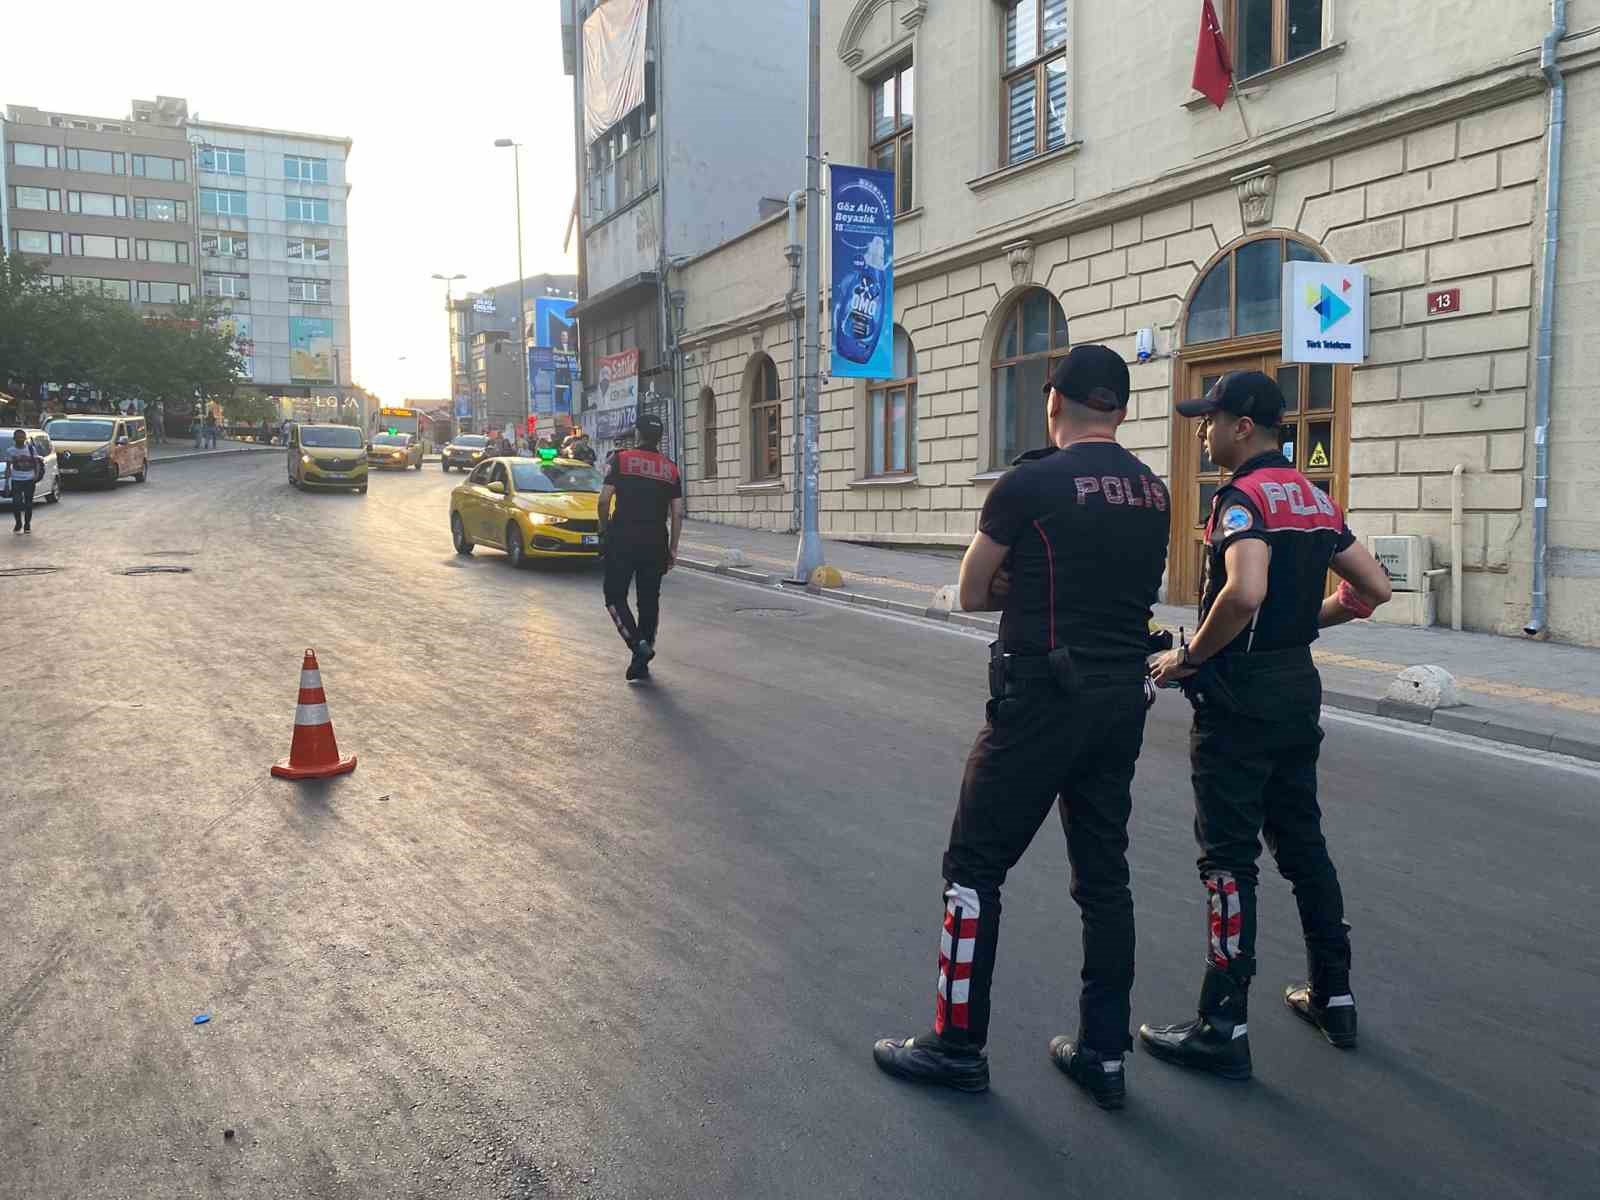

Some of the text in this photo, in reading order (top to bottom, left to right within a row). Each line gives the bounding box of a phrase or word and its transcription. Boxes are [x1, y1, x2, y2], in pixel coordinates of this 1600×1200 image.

[836, 202, 879, 214] Göz Alıcı
[835, 212, 875, 224] Beyazlık
[851, 294, 876, 315] OMO
[1436, 294, 1451, 308] 13
[1072, 474, 1167, 512] POLİS
